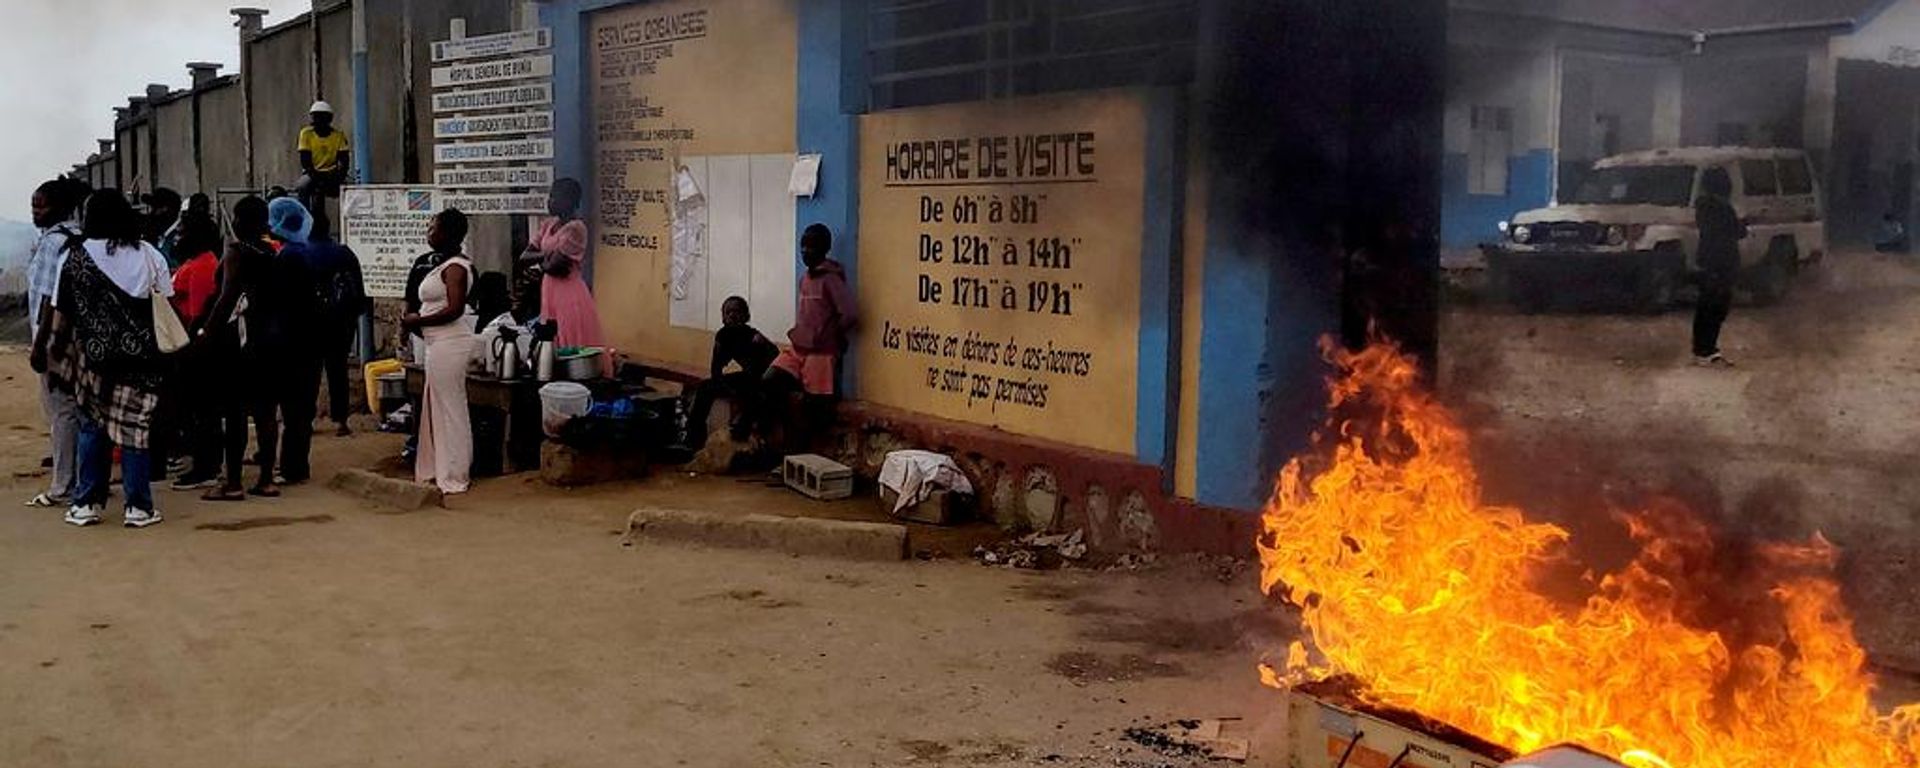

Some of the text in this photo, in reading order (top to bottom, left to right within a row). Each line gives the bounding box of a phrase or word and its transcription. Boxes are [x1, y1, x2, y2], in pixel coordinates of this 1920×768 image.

[598, 21, 641, 47] SERVICES
[886, 132, 1095, 180] HORAIRE DE VISITE
[920, 196, 944, 223] De
[988, 195, 1003, 223] à
[919, 234, 943, 262] De
[1002, 238, 1018, 265] à
[918, 274, 942, 304] De
[1001, 280, 1017, 310] à
[883, 320, 901, 349] Les
[906, 325, 940, 355] visites
[943, 335, 959, 358] en
[1003, 335, 1018, 367] de
[1022, 340, 1091, 376] ces-heures
[927, 364, 1049, 414] ne sont pas permises
